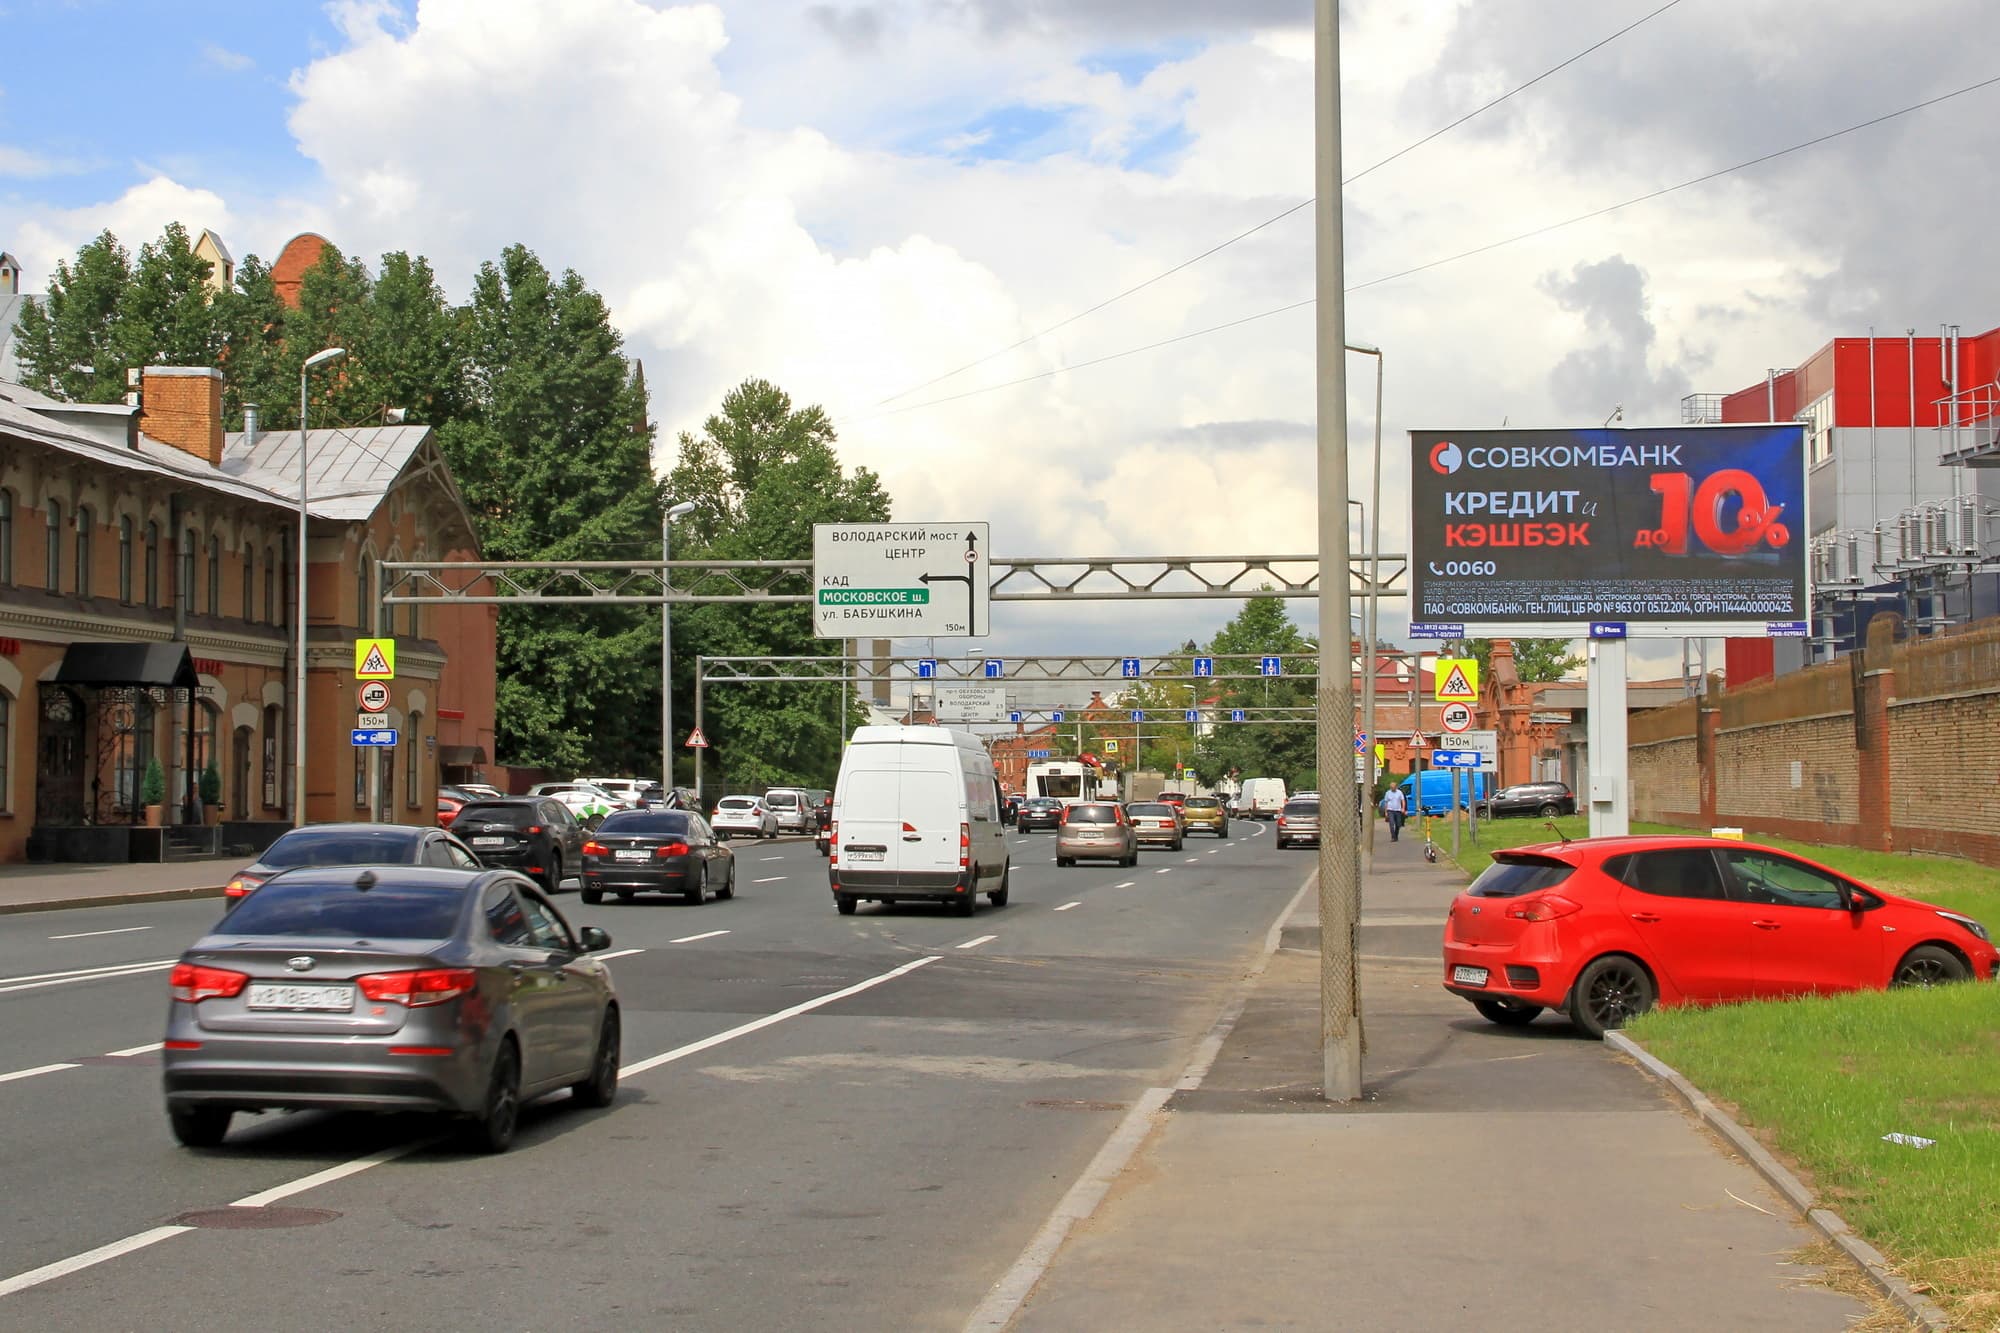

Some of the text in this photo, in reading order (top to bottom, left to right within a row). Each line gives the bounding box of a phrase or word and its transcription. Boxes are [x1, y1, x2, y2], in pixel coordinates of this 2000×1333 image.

[1467, 444, 1682, 468] СОВКОМБАНК
[1444, 490, 1580, 518] КРЕДИТ
[832, 528, 958, 543] ВОЛОДАРСКИЙ мост
[1445, 522, 1591, 547] КЭШБЭК
[885, 549, 926, 560] ЦЕНТР
[1446, 560, 1496, 576] 0060
[823, 576, 849, 587] КАД
[823, 591, 925, 603] МОСКОВСКОЕ ш.
[823, 608, 922, 620] ул. БАБУШКИНА
[1424, 602, 1444, 614] ПАО
[1446, 602, 1524, 614] «СОВКОМБАНК».
[1526, 602, 1545, 614] ГЕН.
[1547, 602, 1571, 614] ЛИЦ.
[1572, 602, 1586, 613] ЦБ
[1588, 602, 1602, 613] РФ
[1604, 602, 1614, 613] №
[1615, 602, 1631, 613] 963
[1633, 602, 1646, 613] ОТ
[1648, 602, 1692, 613] 05.12.2014,
[1694, 602, 1720, 613] ОГРН
